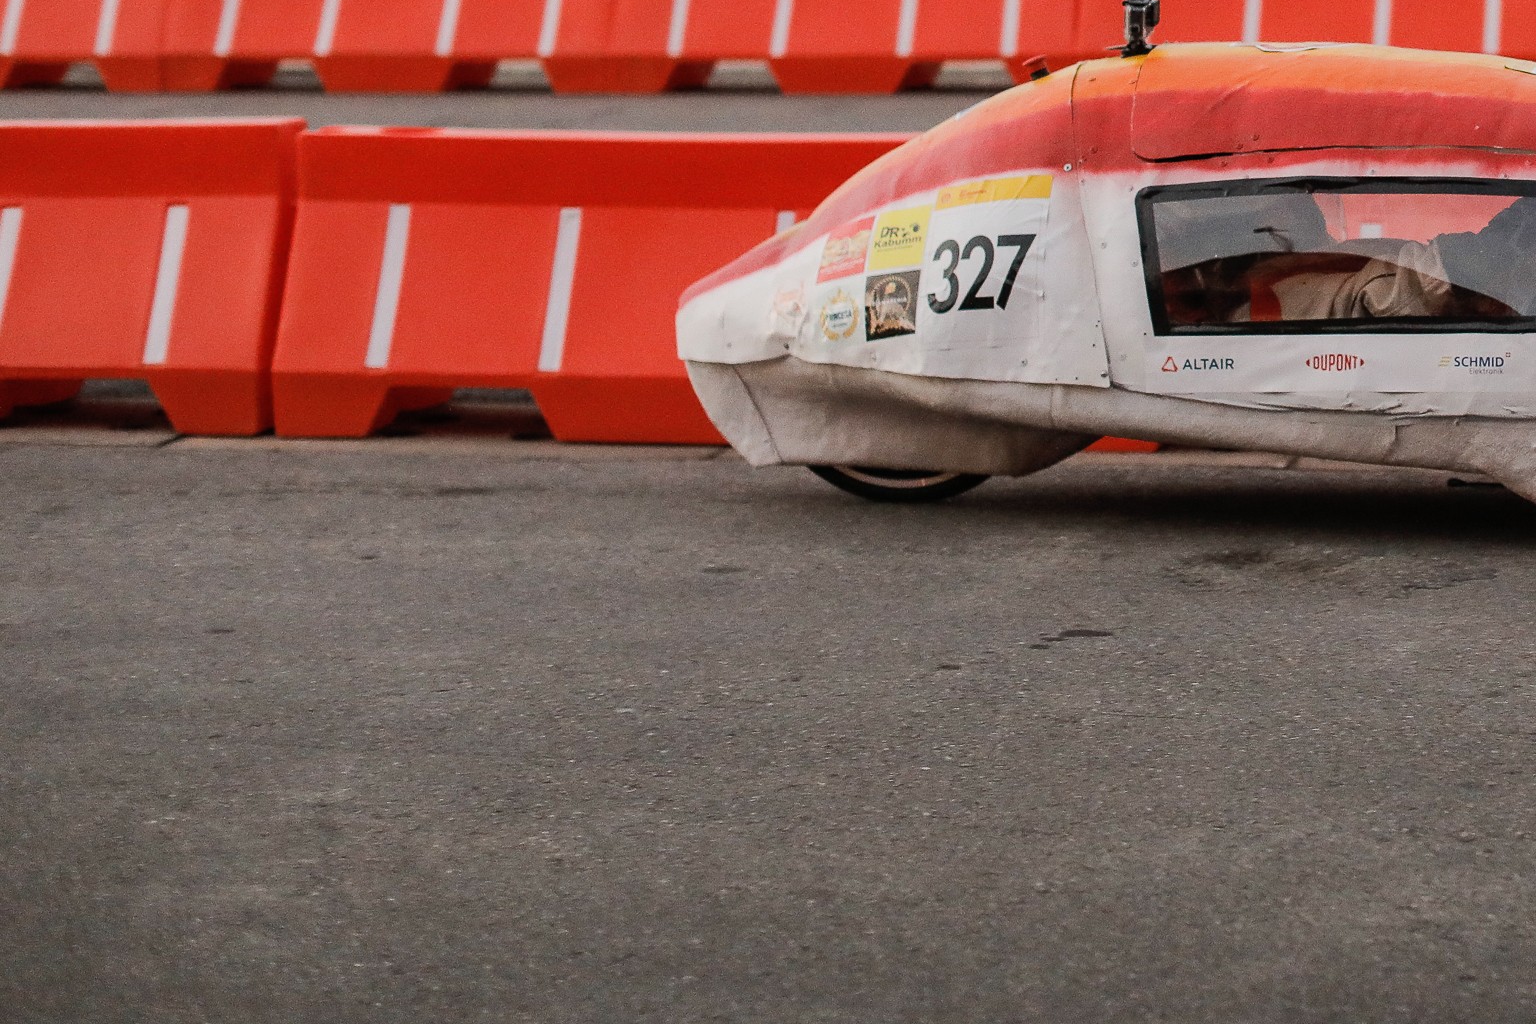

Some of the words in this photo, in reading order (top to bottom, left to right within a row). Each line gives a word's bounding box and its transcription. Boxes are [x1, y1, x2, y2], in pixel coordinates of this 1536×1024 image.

[927, 234, 1037, 314] 327
[1183, 358, 1235, 370] ALTAIR
[1312, 353, 1359, 372] DUPONT
[1454, 356, 1504, 368] SCHMID
